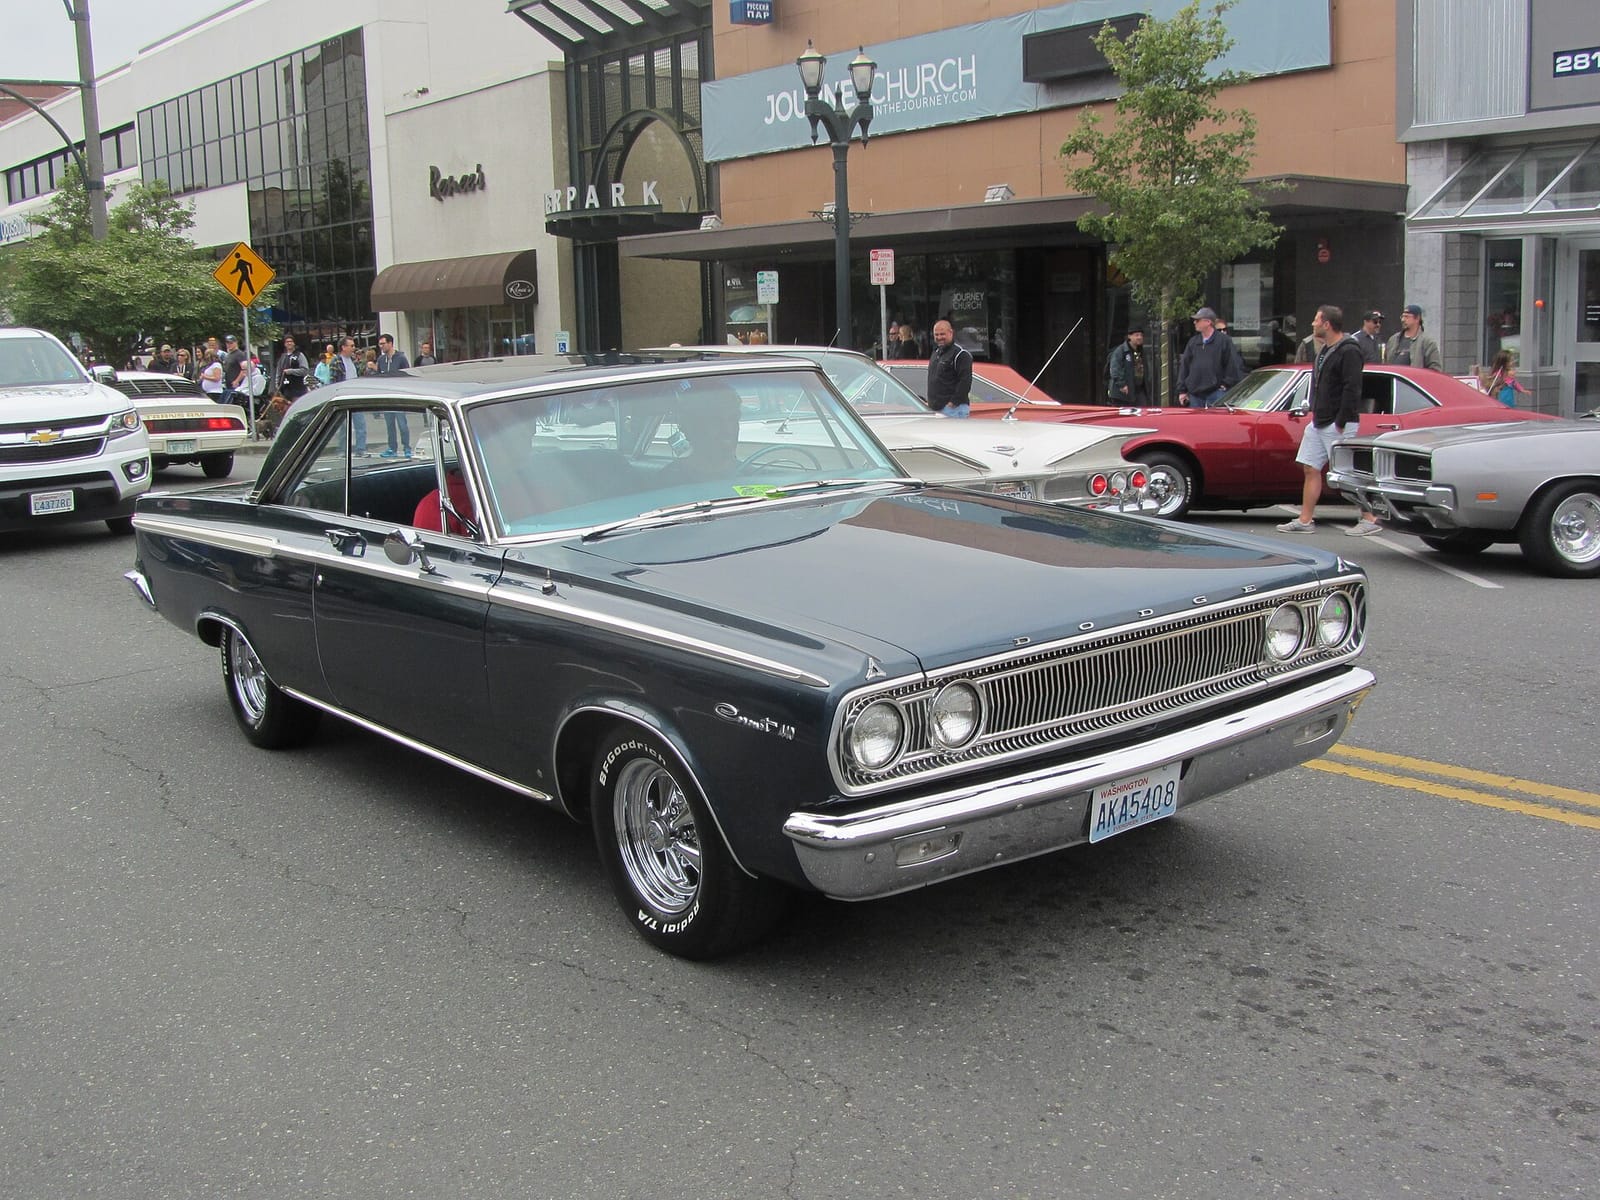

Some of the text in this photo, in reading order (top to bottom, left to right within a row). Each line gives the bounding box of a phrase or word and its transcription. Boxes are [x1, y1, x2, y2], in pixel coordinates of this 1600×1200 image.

[747, 10, 770, 19] ПАР
[870, 54, 977, 105] CHURCH
[599, 739, 667, 787] BFGoodrich
[1096, 780, 1175, 832] AKA5408
[1101, 777, 1149, 800] WASHINGTON
[638, 900, 700, 933] Radial T/A
